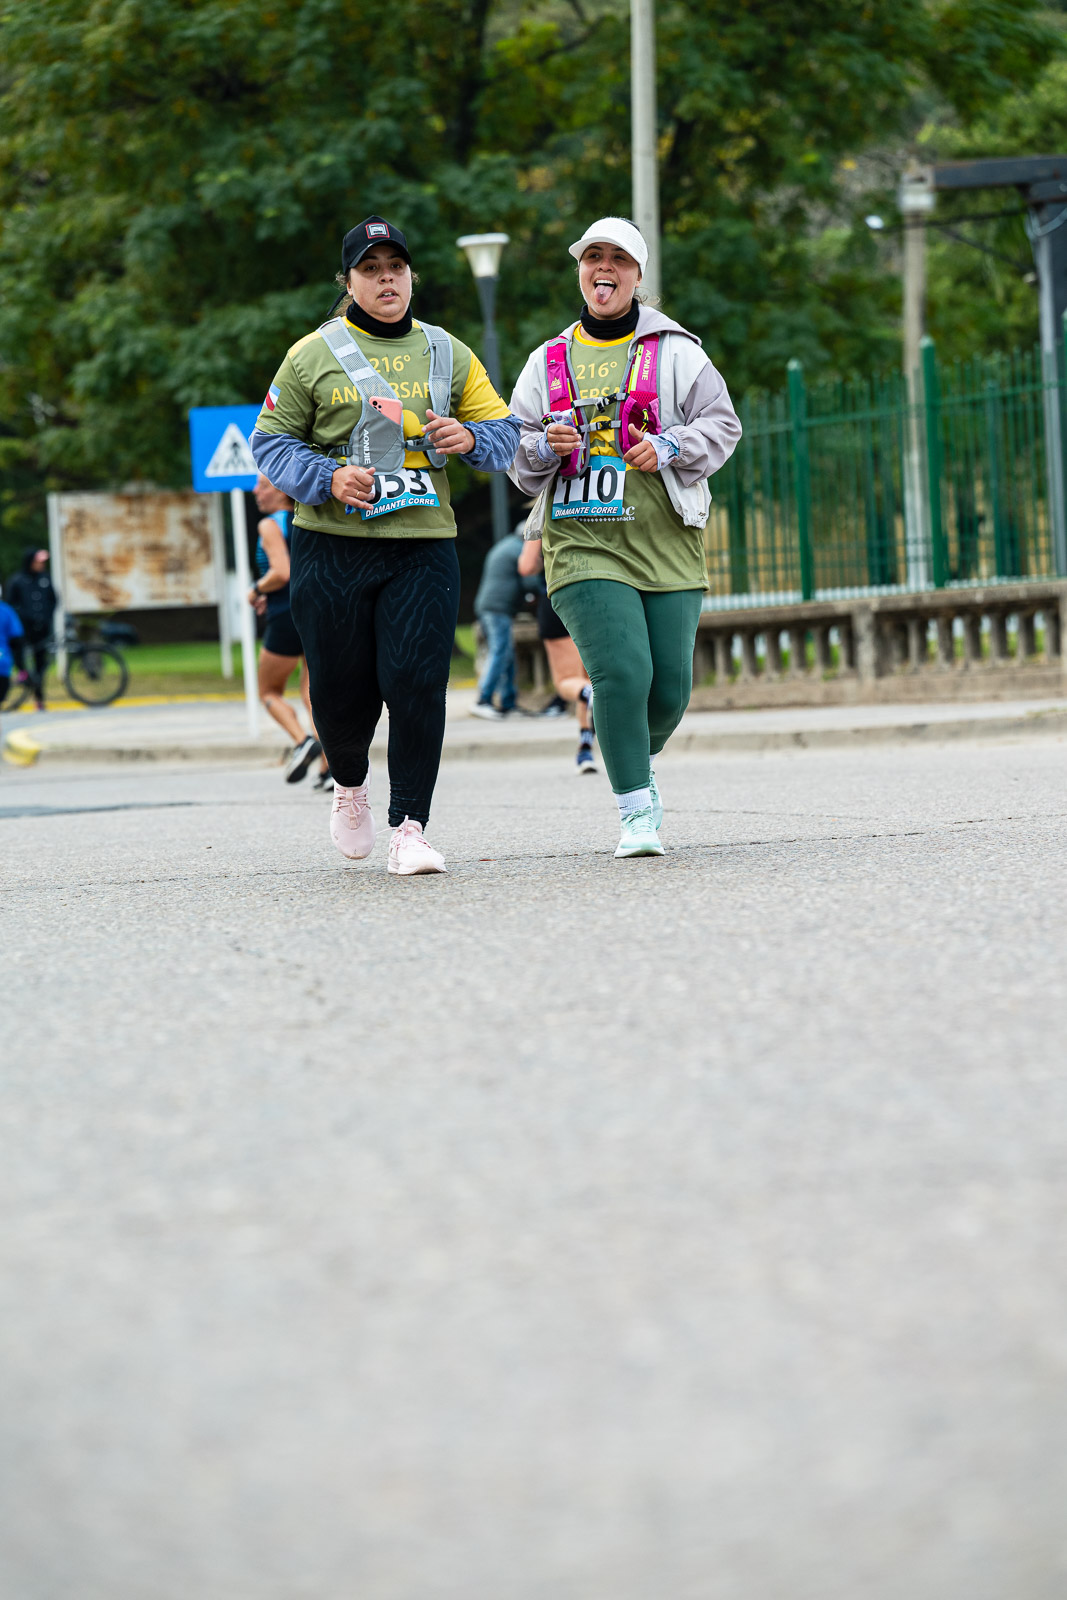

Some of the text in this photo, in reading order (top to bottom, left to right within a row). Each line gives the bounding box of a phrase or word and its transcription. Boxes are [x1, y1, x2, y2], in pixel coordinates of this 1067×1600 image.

[575, 361, 618, 380] 216°
[363, 428, 371, 465] AONIJIE
[561, 465, 618, 506] 110
[365, 498, 407, 518] DIAMANTE
[554, 506, 590, 517] DIAMANTE
[590, 506, 619, 514] CORRE
